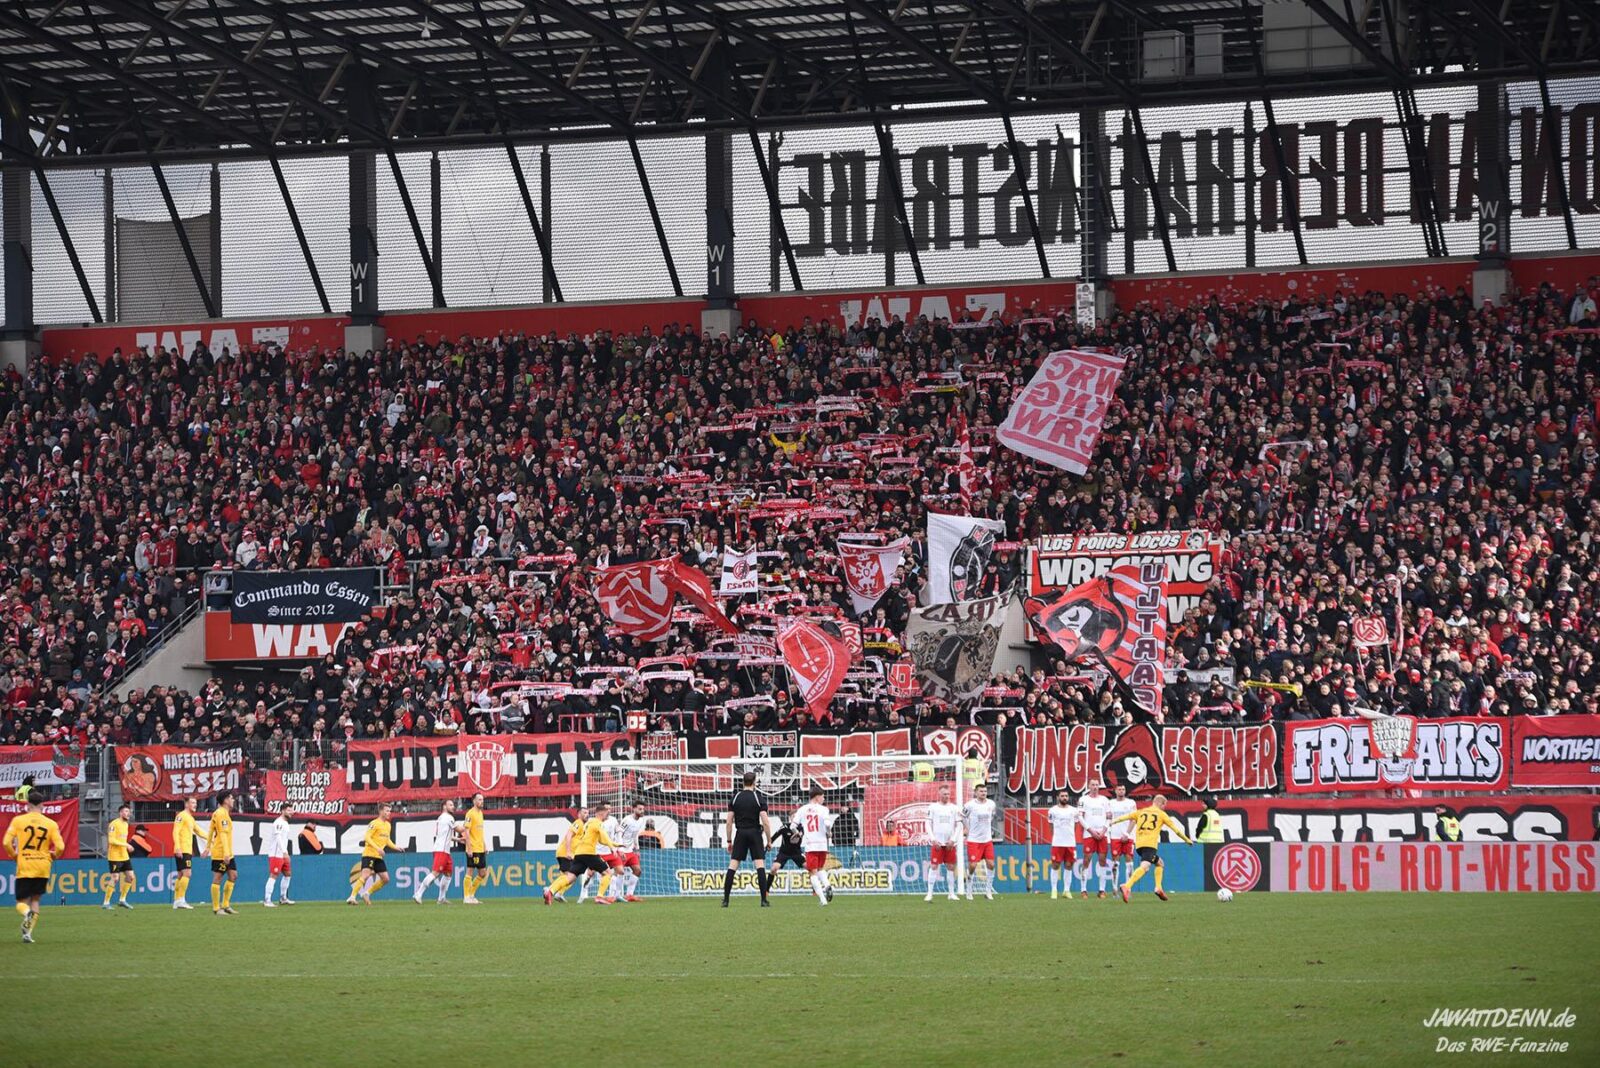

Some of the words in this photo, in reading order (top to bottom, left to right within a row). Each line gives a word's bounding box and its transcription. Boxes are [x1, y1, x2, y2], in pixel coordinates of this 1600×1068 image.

[1480, 200, 1500, 220] W
[707, 245, 725, 262] W
[350, 262, 368, 280] W
[711, 266, 720, 286] 1
[355, 284, 363, 303] 1
[1044, 536, 1074, 551] LOS
[1130, 533, 1182, 550] LOCOS
[1040, 554, 1213, 586] WRENG
[234, 580, 320, 608] Commando
[325, 581, 370, 607] Essen
[267, 605, 302, 617] Since
[305, 603, 335, 617] 2012
[163, 747, 243, 770] HAFENSÄNGER
[1008, 724, 1106, 794] JUNGE
[1162, 724, 1278, 792] ESSENER
[1292, 722, 1501, 784] FREAKS
[1523, 736, 1600, 762] NORTHSI
[351, 744, 458, 791] RUDE
[513, 738, 631, 786] FANS
[170, 768, 240, 795] ESSEN
[281, 772, 307, 786] EHRE
[310, 772, 331, 786] DER
[286, 786, 325, 800] GRUPPE
[267, 799, 346, 815] STONVERBOT
[806, 814, 819, 833] 21
[1139, 813, 1158, 831] 23
[22, 825, 48, 851] 27
[1401, 843, 1597, 892] ROT-WEISS
[678, 871, 890, 891] TEAMSPRTBEARF.DE
